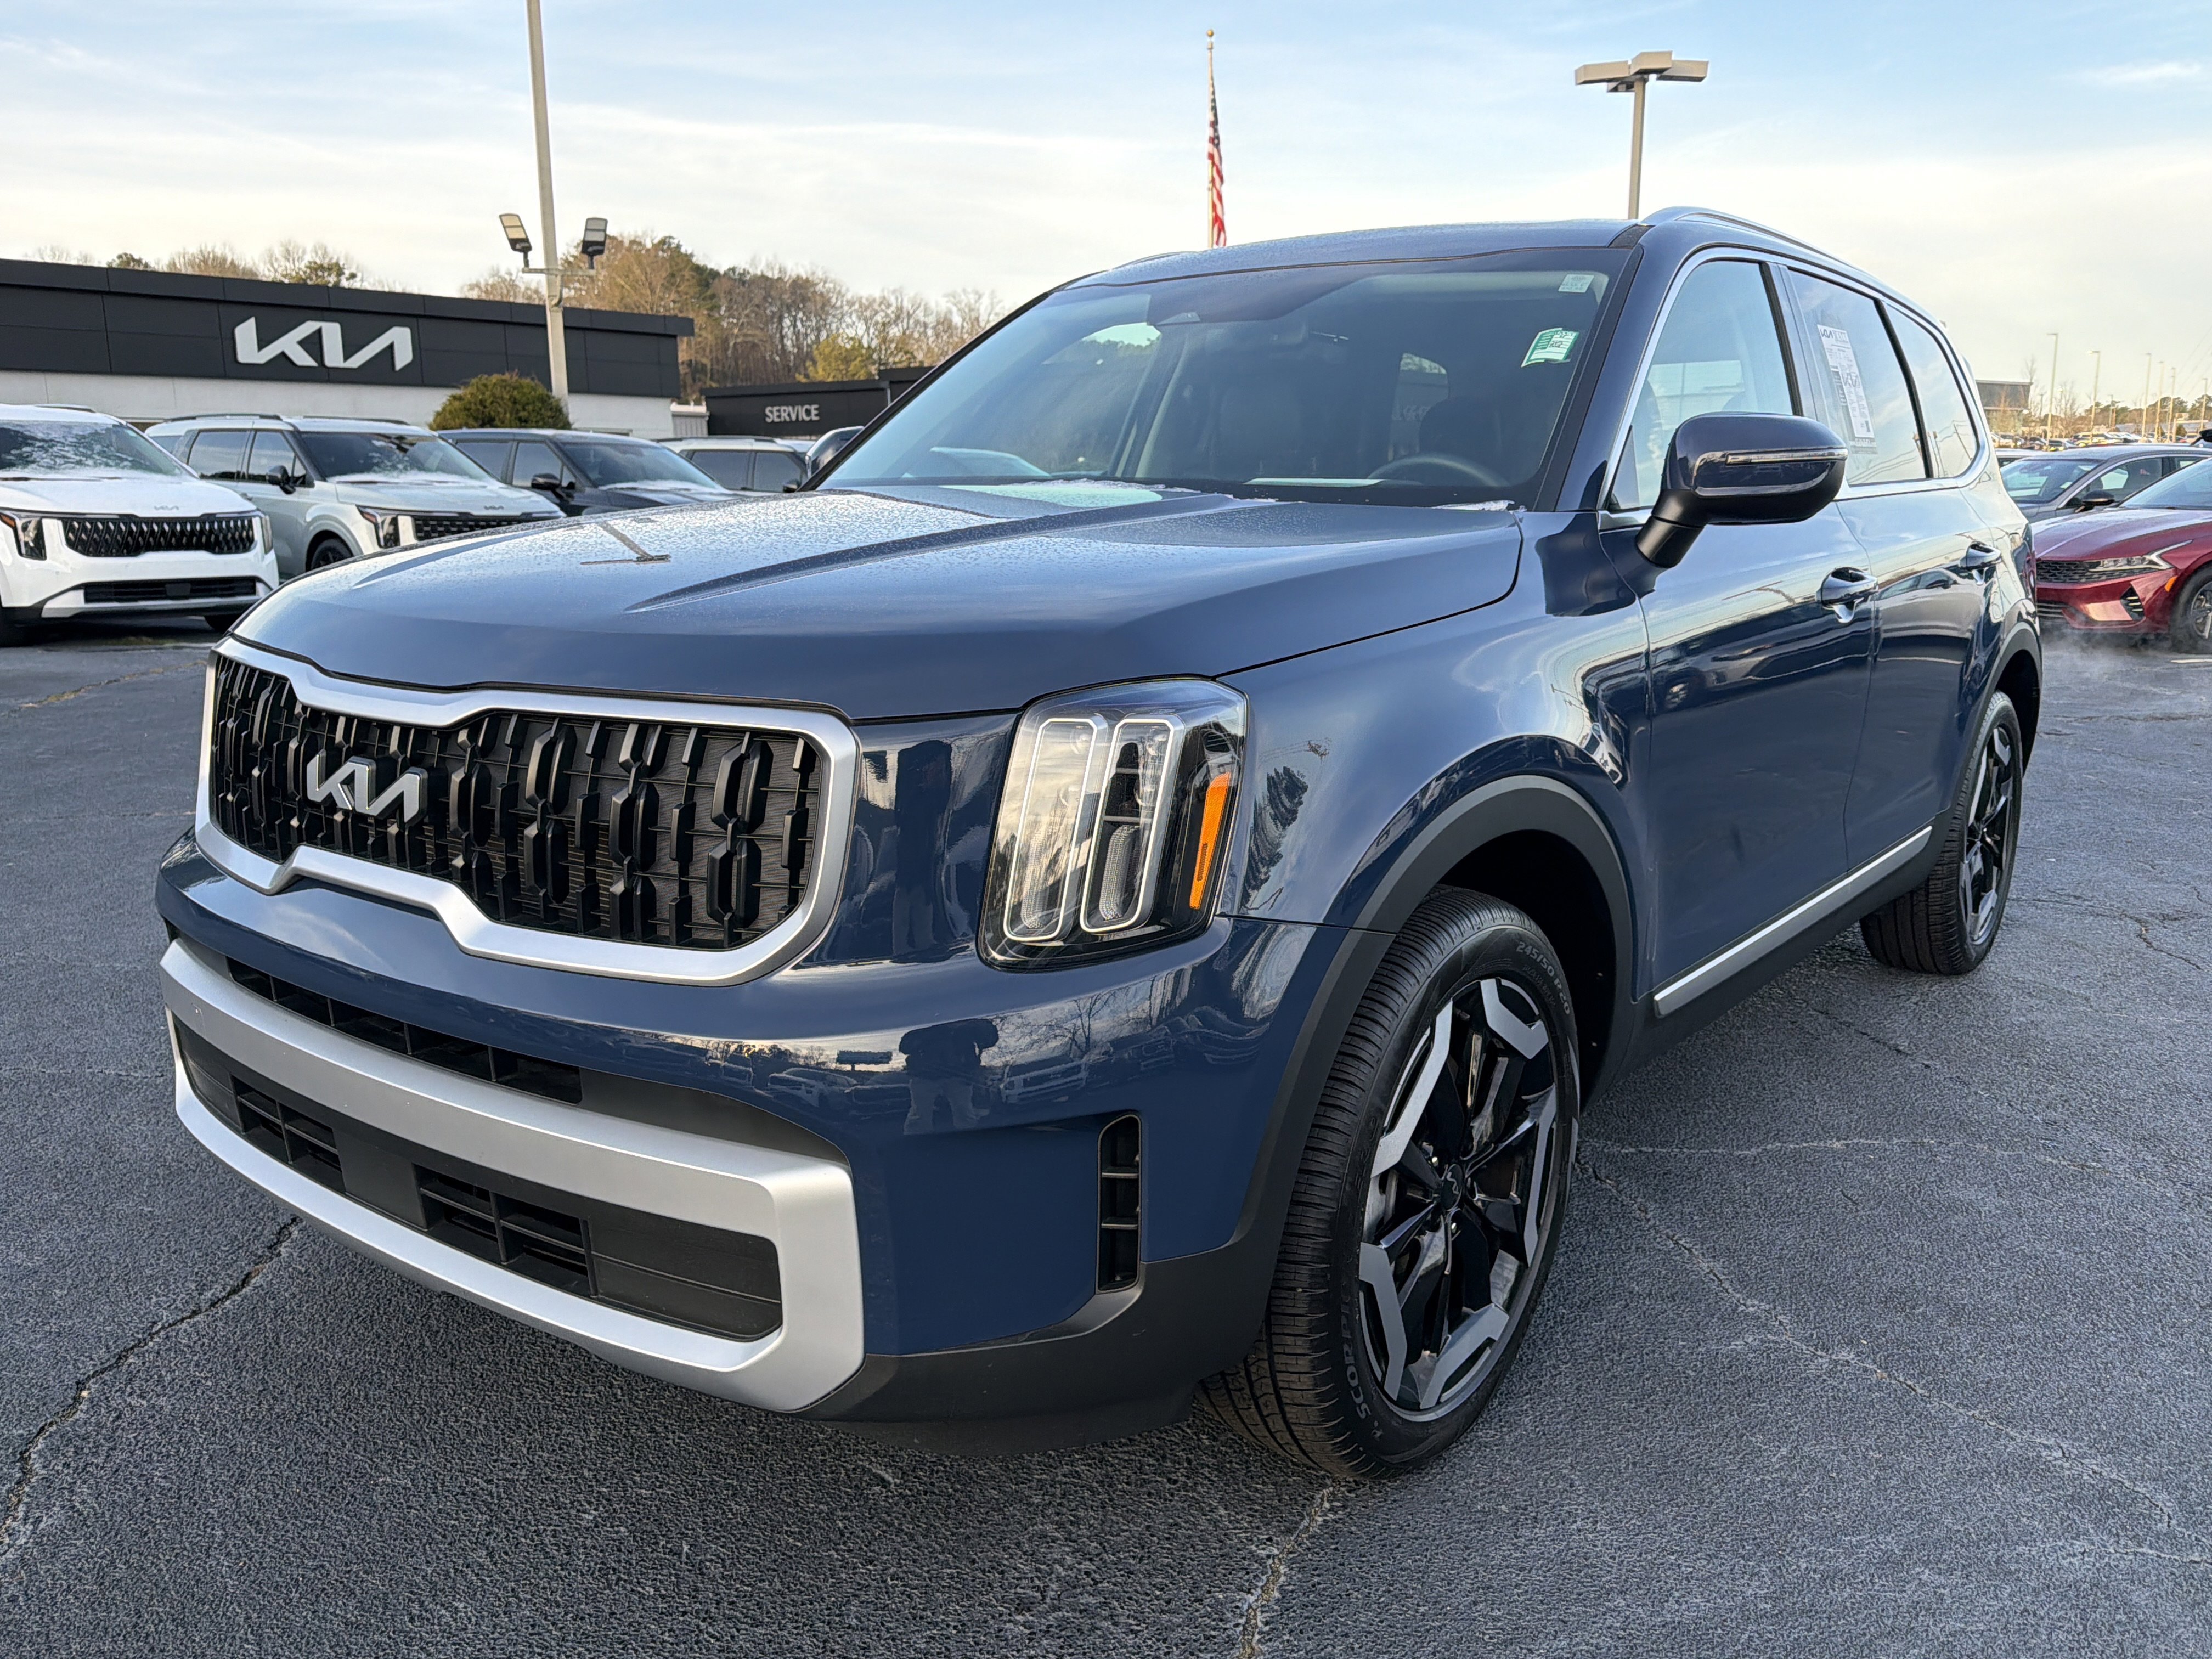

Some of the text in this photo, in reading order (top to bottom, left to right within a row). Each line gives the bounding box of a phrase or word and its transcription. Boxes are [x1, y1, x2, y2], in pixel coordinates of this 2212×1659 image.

[234, 316, 413, 371] KIA
[765, 404, 820, 423] SERVICE
[306, 749, 428, 823] KIA
[1516, 941, 1555, 977] 245/50
[1340, 1284, 1372, 1420] SCORPI
